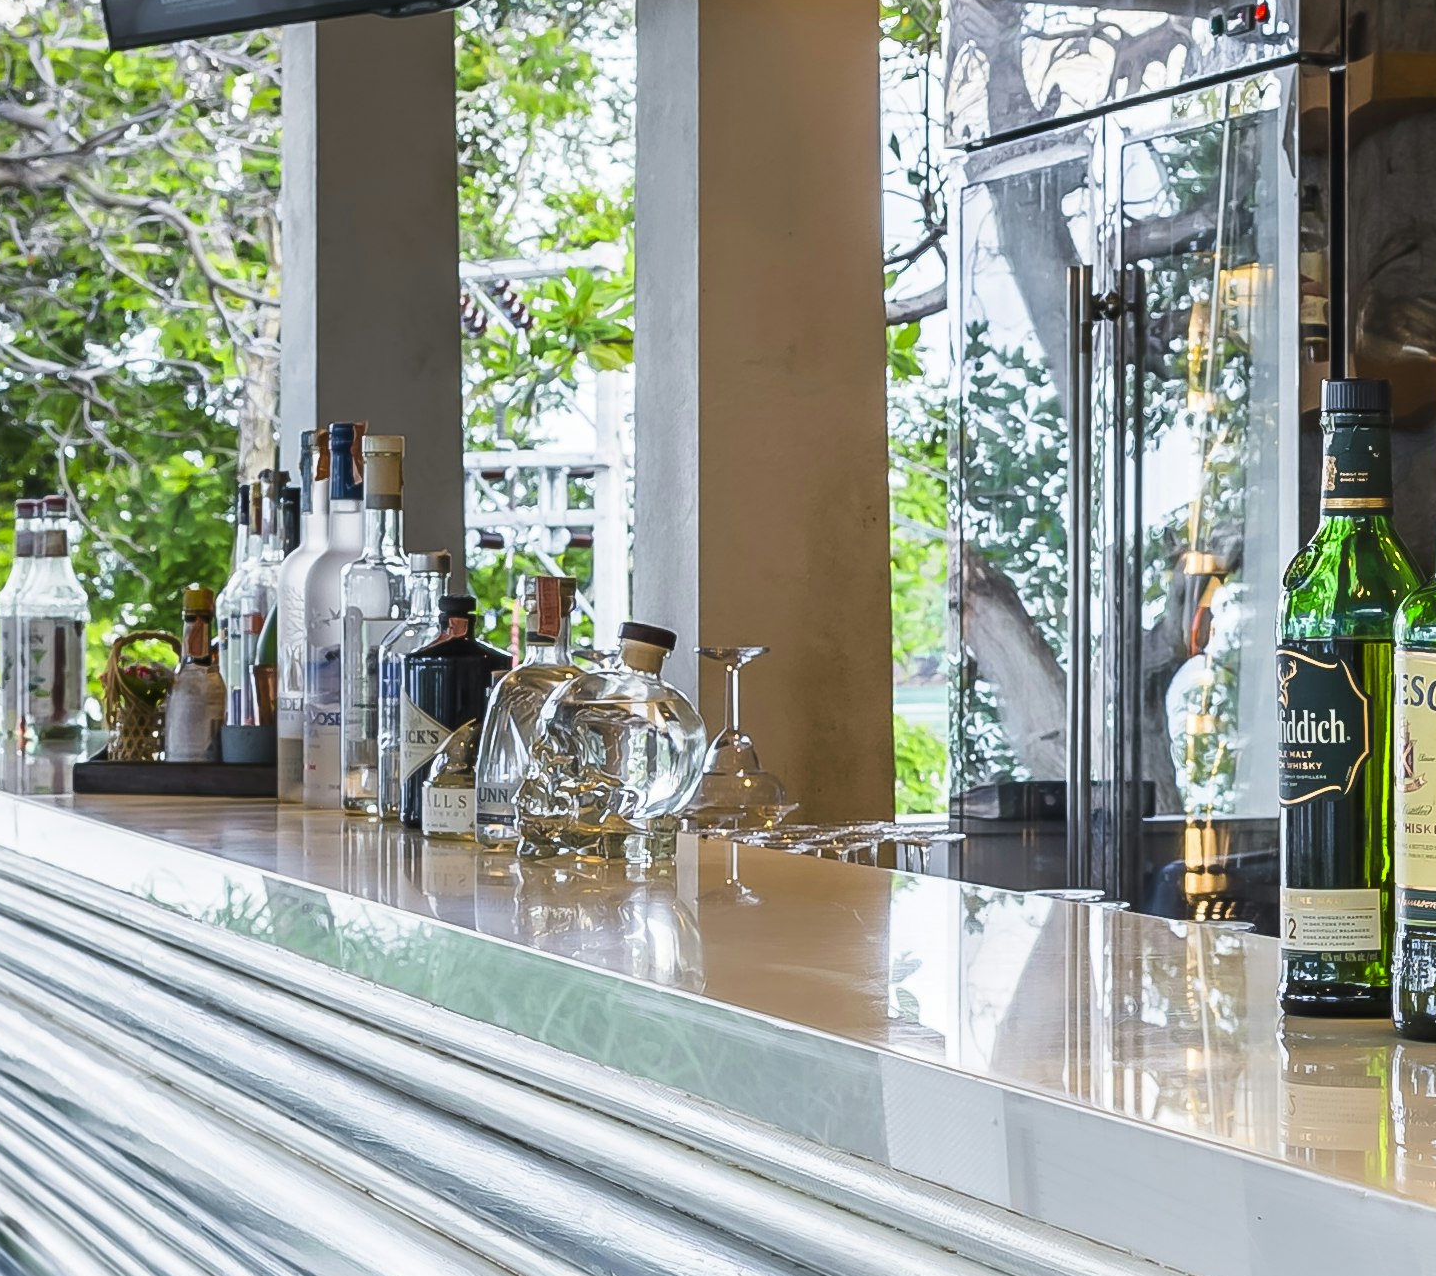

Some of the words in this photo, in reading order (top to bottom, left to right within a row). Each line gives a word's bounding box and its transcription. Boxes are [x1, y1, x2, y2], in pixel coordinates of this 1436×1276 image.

[1278, 708, 1347, 744] fiddich
[1289, 750, 1313, 758] MALT
[1286, 762, 1323, 770] WHISKY
[478, 786, 509, 804] UNN
